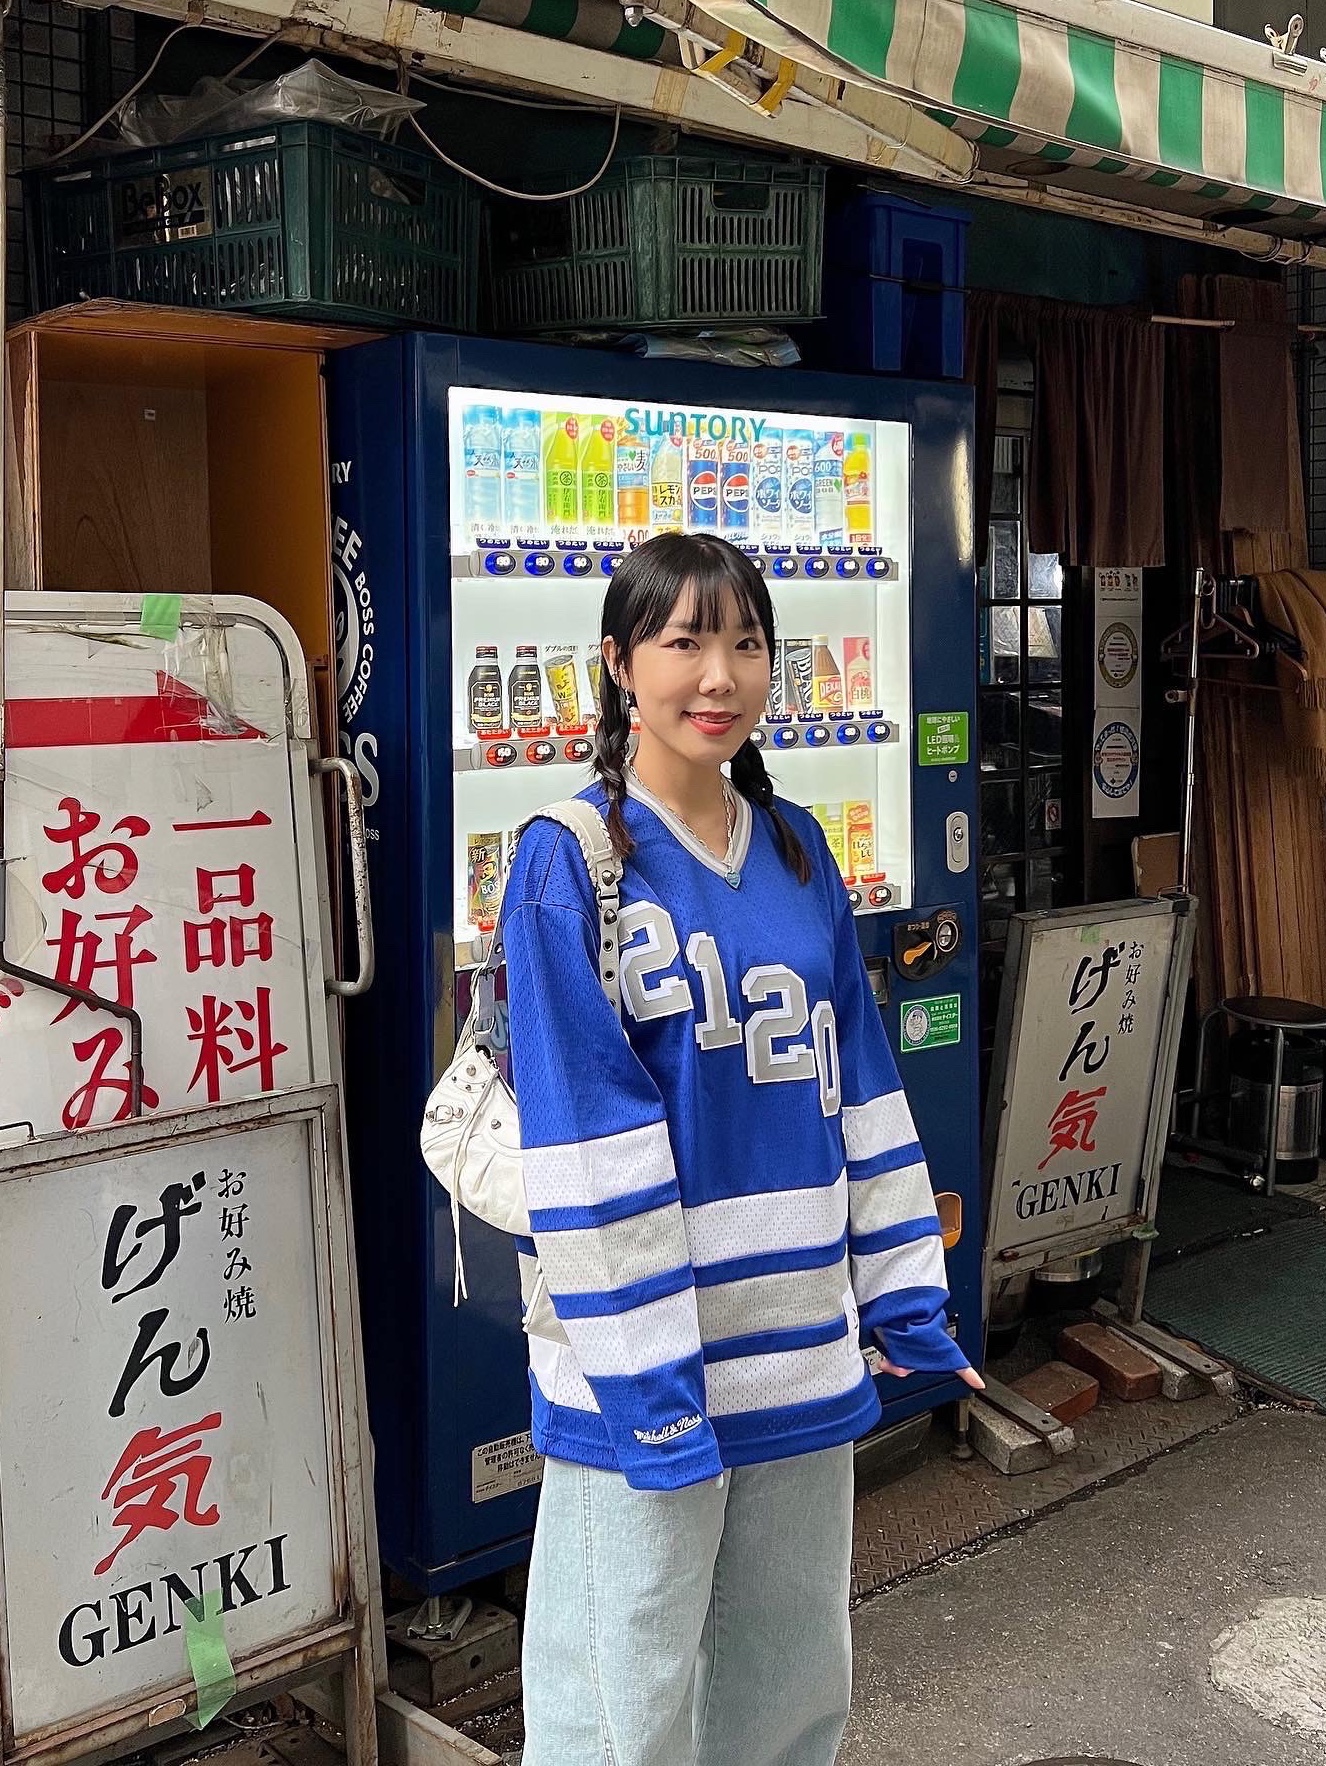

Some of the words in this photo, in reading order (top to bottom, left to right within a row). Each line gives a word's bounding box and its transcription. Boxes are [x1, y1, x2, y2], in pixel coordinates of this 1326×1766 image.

[355, 572, 374, 636] BOSS
[42, 797, 160, 1130] お好み
[617, 900, 842, 1118] 2120
[1118, 941, 1144, 1034] お好み焼
[1037, 941, 1126, 1170] げん気
[217, 1168, 257, 1324] お好み焼
[1017, 1162, 1122, 1220] GENKI
[94, 1170, 222, 1576] げん気
[58, 1534, 291, 1668] GENKI
